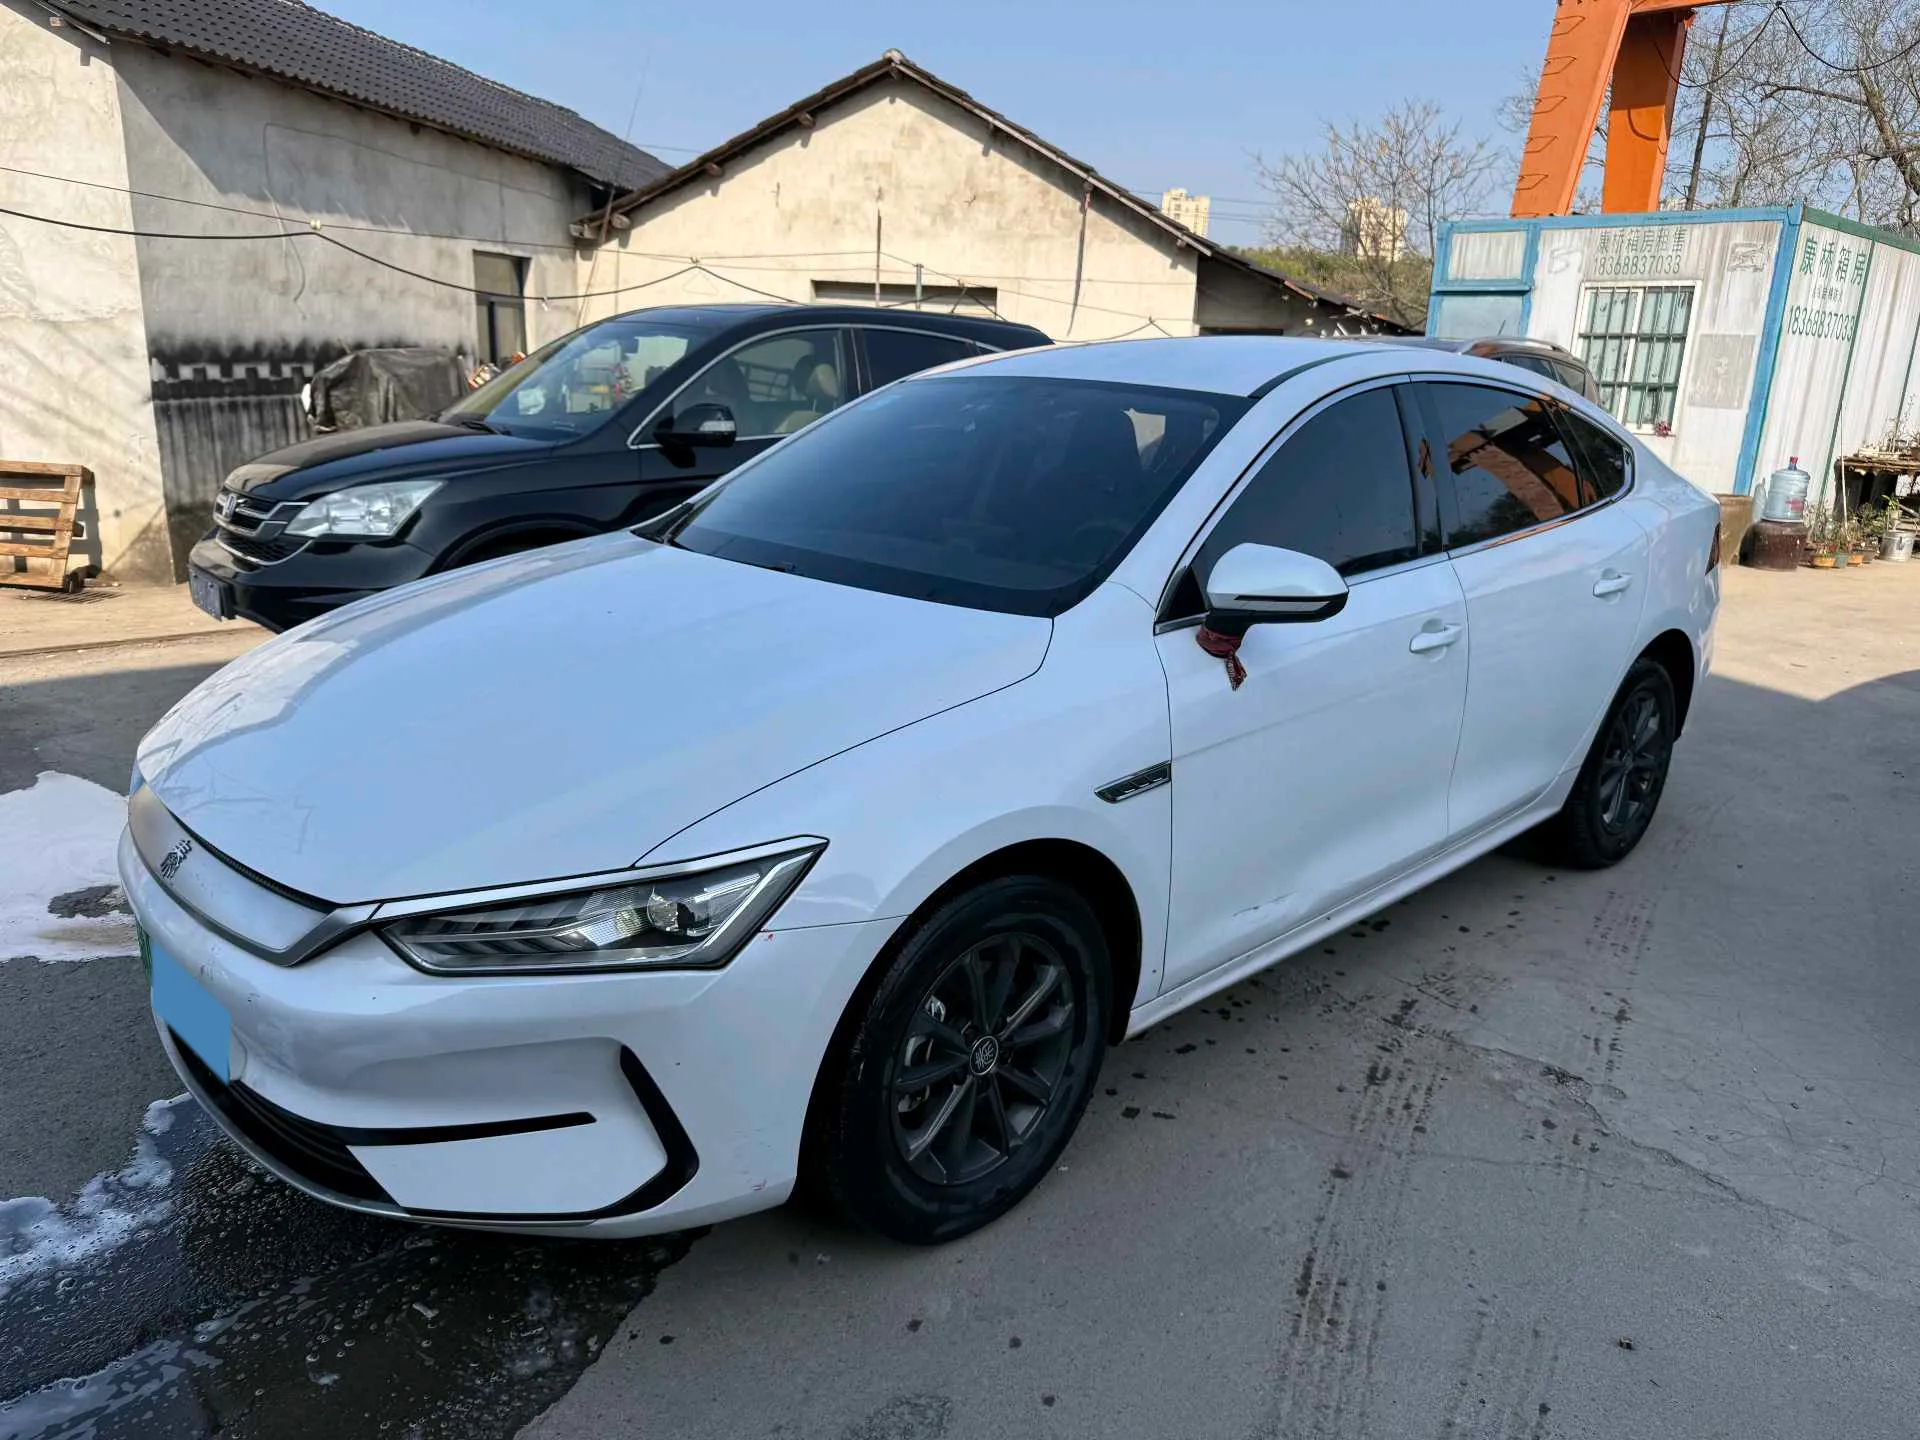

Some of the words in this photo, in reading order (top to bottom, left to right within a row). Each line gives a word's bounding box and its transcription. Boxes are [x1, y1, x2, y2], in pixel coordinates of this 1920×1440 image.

[1594, 255, 1681, 275] 18368837033
[1799, 236, 1866, 286] 康桥箱房
[1787, 305, 1855, 342] 18368837033
